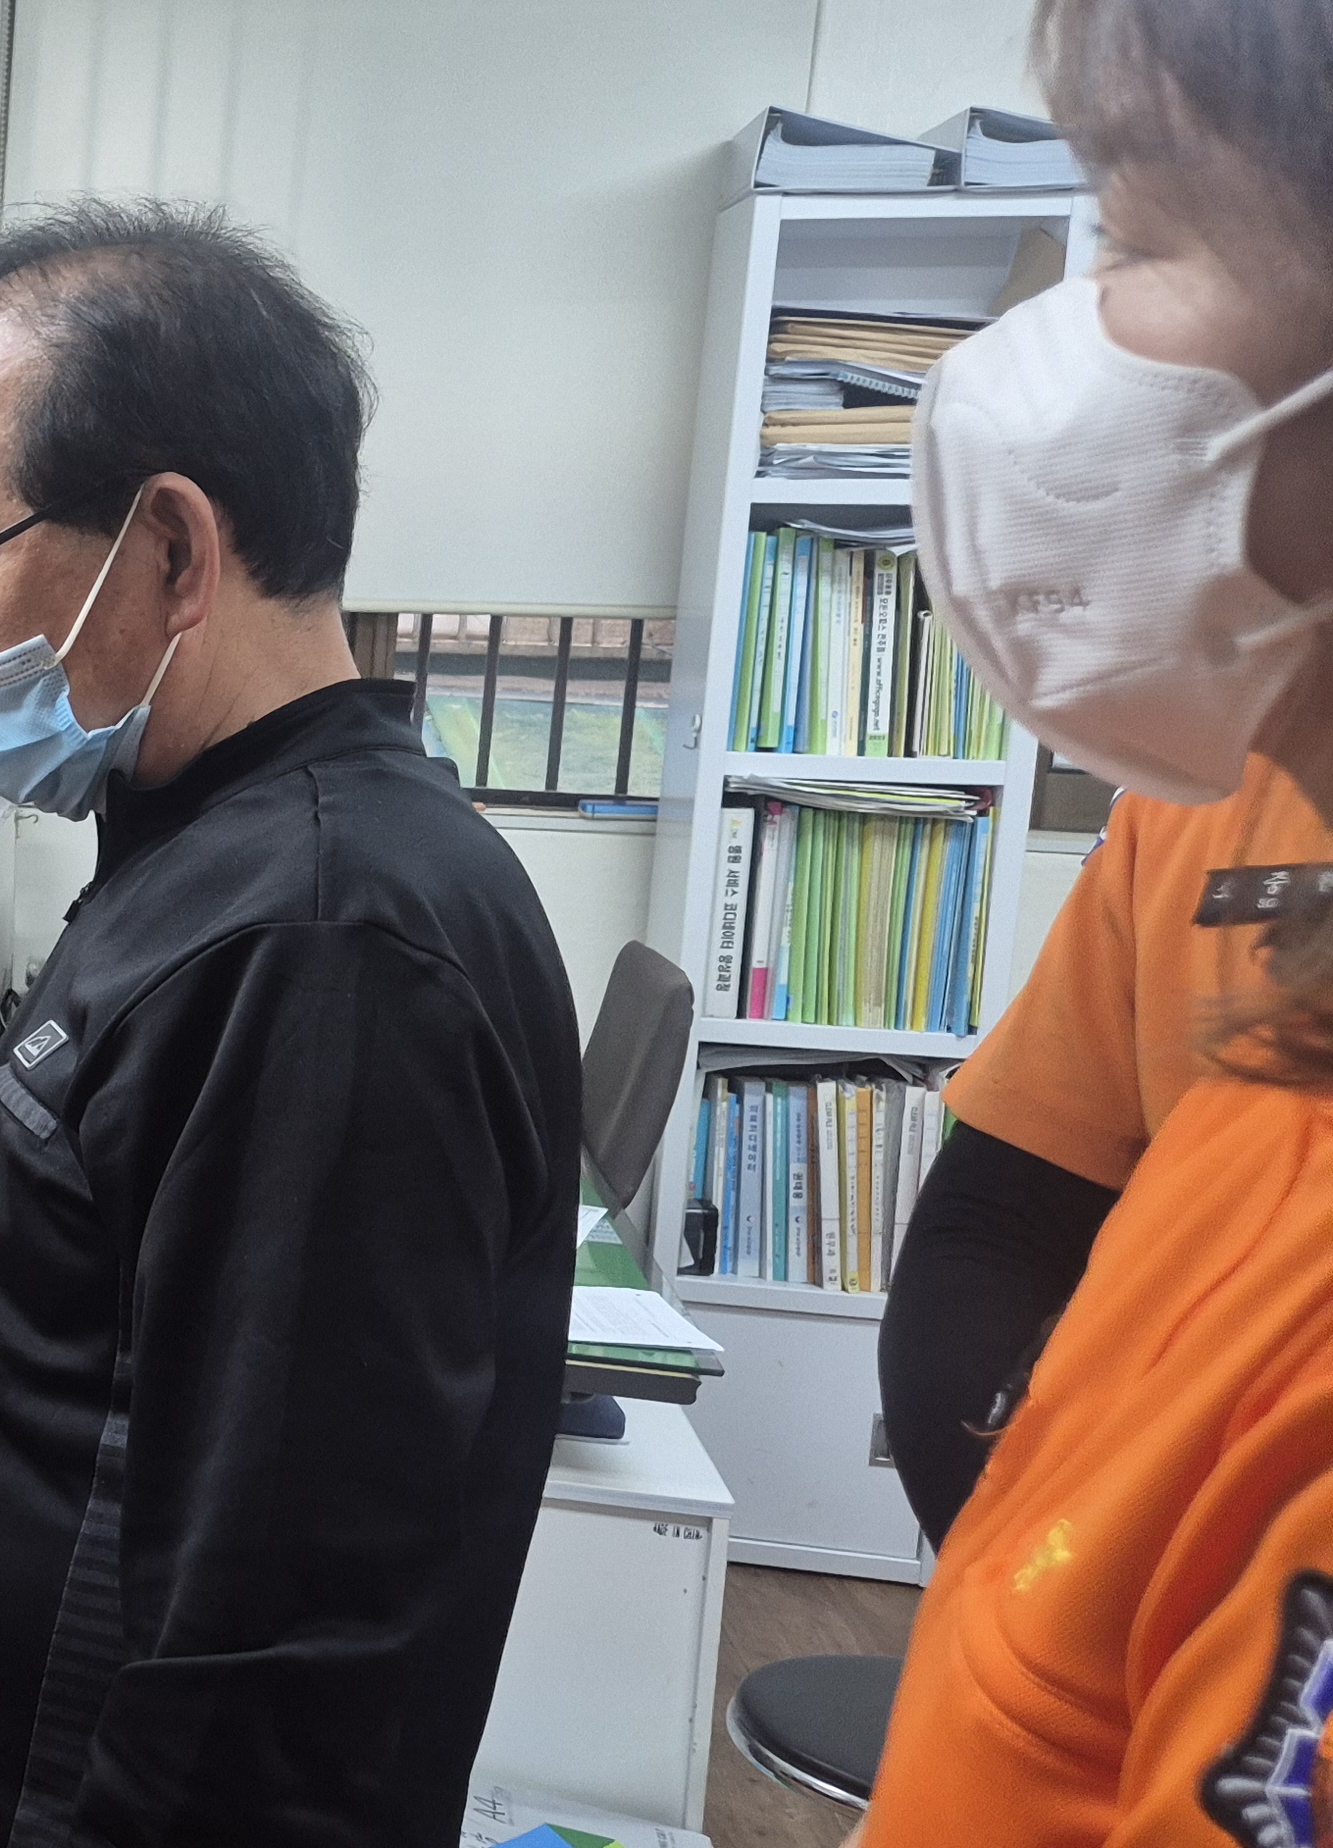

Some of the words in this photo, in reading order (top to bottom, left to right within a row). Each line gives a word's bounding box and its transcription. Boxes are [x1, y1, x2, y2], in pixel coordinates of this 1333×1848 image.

[726, 844, 743, 864] 병원
[724, 868, 741, 898] 서비스
[720, 902, 738, 950] 코디네이터
[473, 1795, 507, 1824] A4
